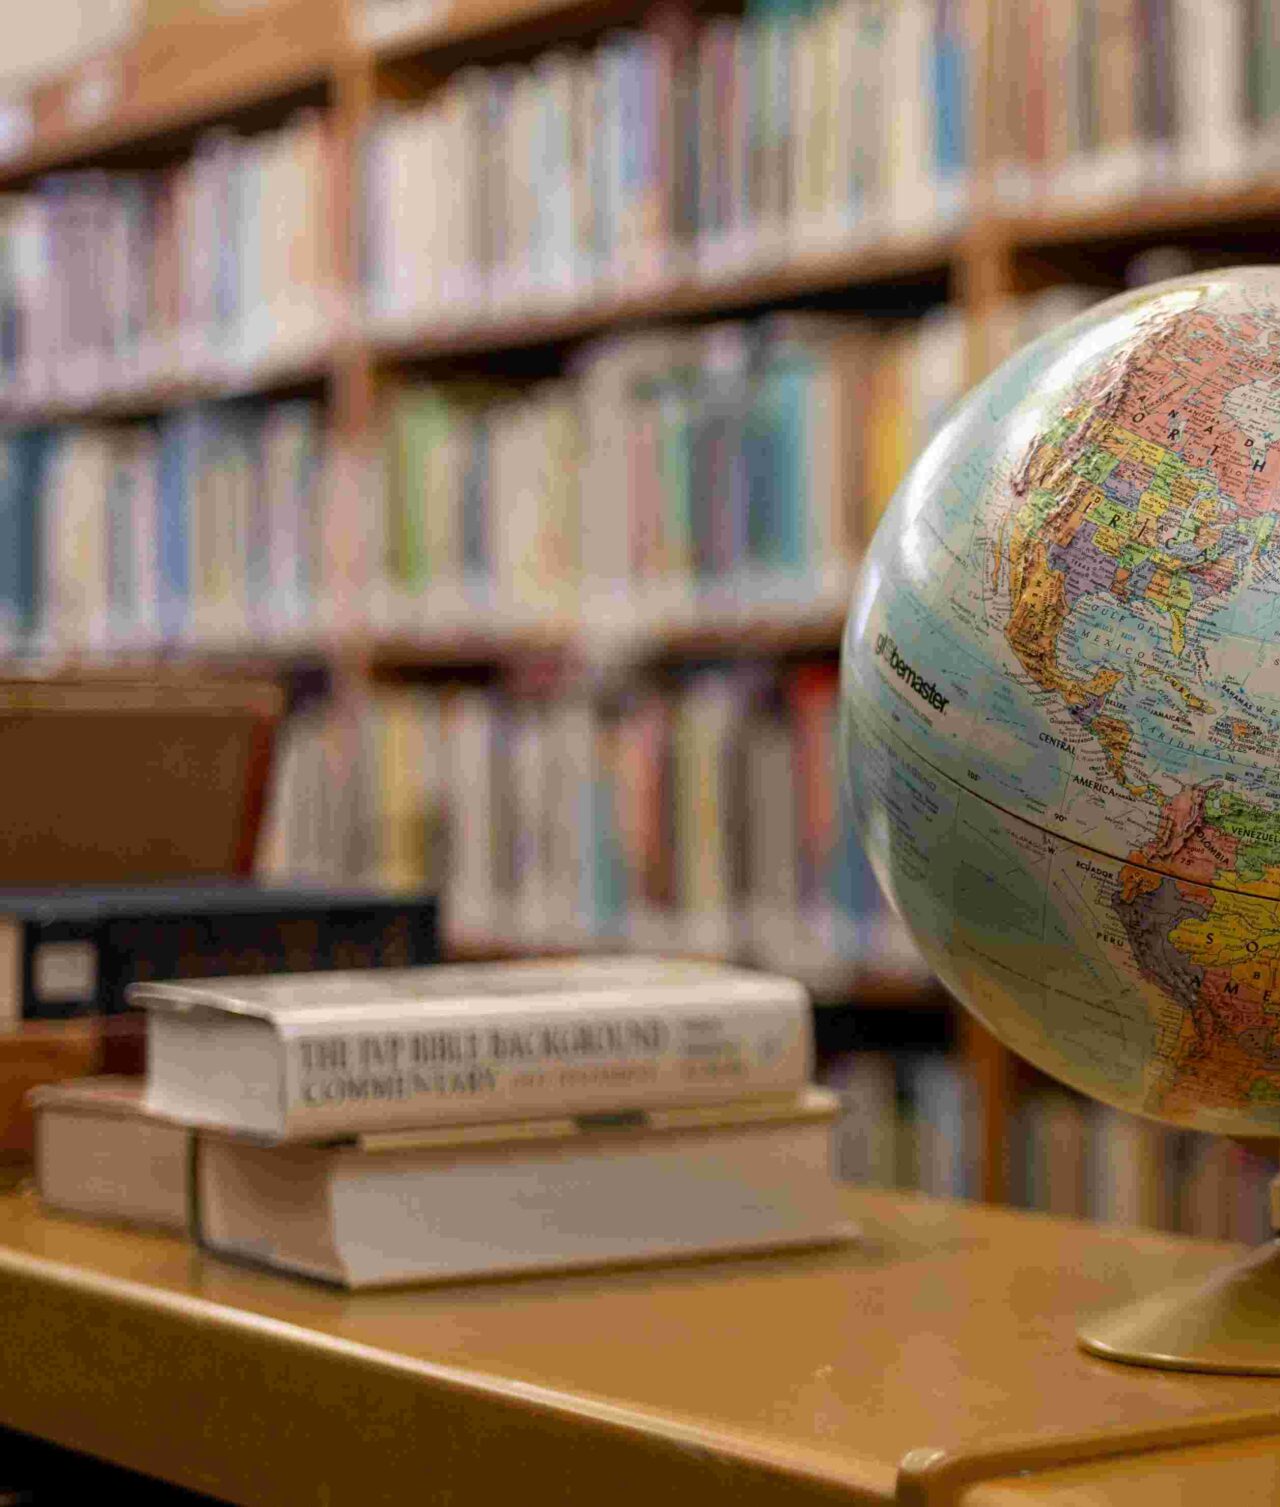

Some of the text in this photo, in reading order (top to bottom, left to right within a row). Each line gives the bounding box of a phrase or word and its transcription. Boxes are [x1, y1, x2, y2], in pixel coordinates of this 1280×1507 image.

[1091, 604, 1126, 623] GULF
[1081, 628, 1145, 659] MEXICO
[874, 633, 950, 713] globemaster
[1221, 684, 1252, 711] BAHAMAS
[1149, 709, 1181, 723] JAMAICA
[1038, 731, 1077, 755] CENTRAL
[1140, 716, 1236, 765] CARIBBEAN
[1072, 774, 1117, 797] AMERICA
[1075, 858, 1114, 879] ECUADOR
[1180, 857, 1194, 866] 75°
[1095, 931, 1124, 948] PERU
[488, 1016, 668, 1060] BACKGROUND
